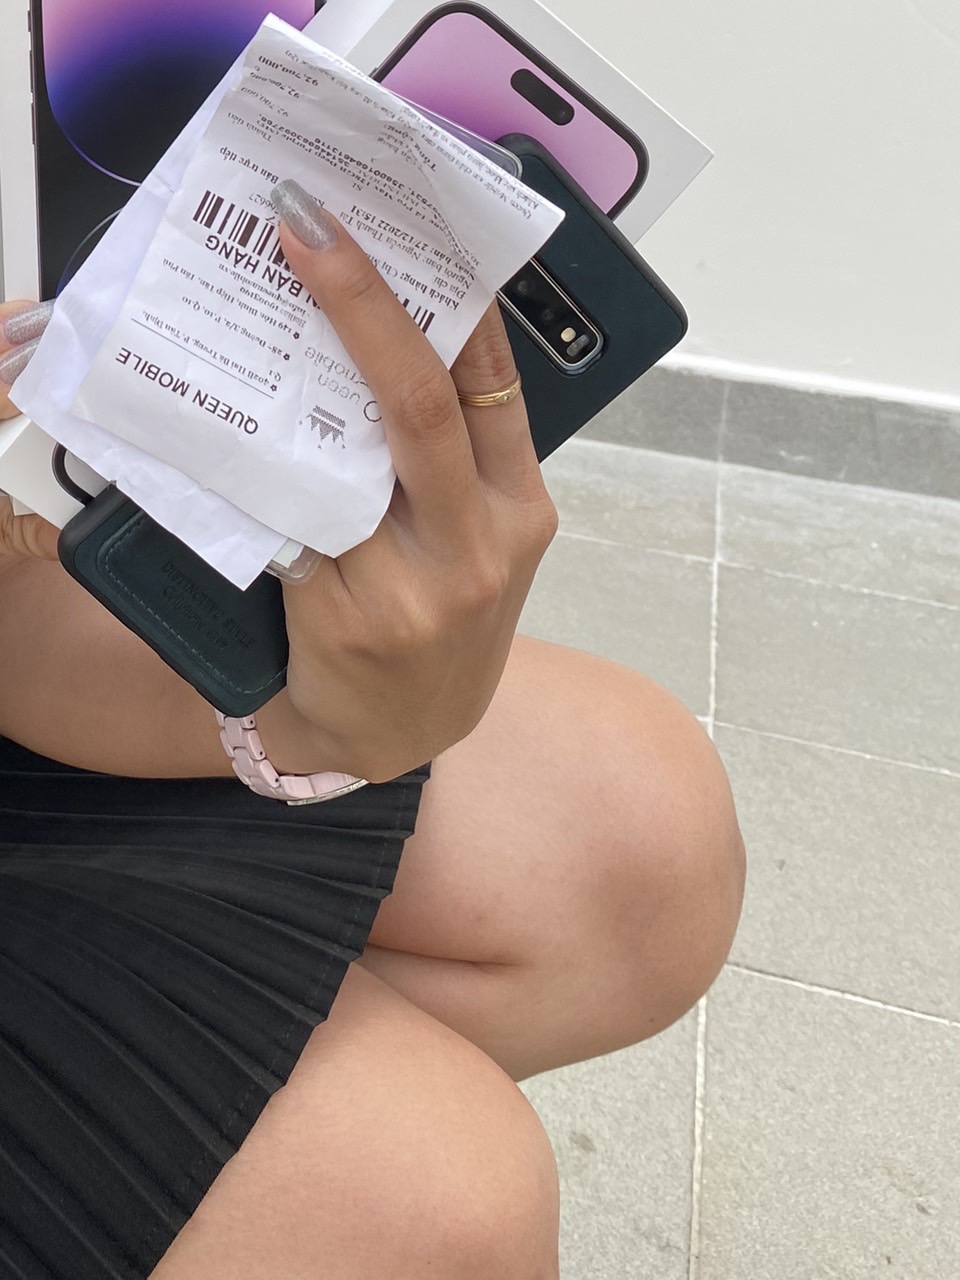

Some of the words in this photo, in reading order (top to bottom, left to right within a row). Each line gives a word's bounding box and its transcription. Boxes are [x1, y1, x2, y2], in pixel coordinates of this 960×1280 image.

[259, 168, 279, 184] Bán
[349, 204, 376, 223] 15:31
[376, 219, 428, 251] 27/12/2022
[202, 233, 260, 274] HÀNG
[259, 264, 305, 299] BÁN
[398, 271, 428, 294] hàng:
[448, 283, 466, 300] Địa
[427, 287, 460, 311] Khách
[114, 346, 190, 397] MOBILE
[191, 388, 259, 435] QUEEN
